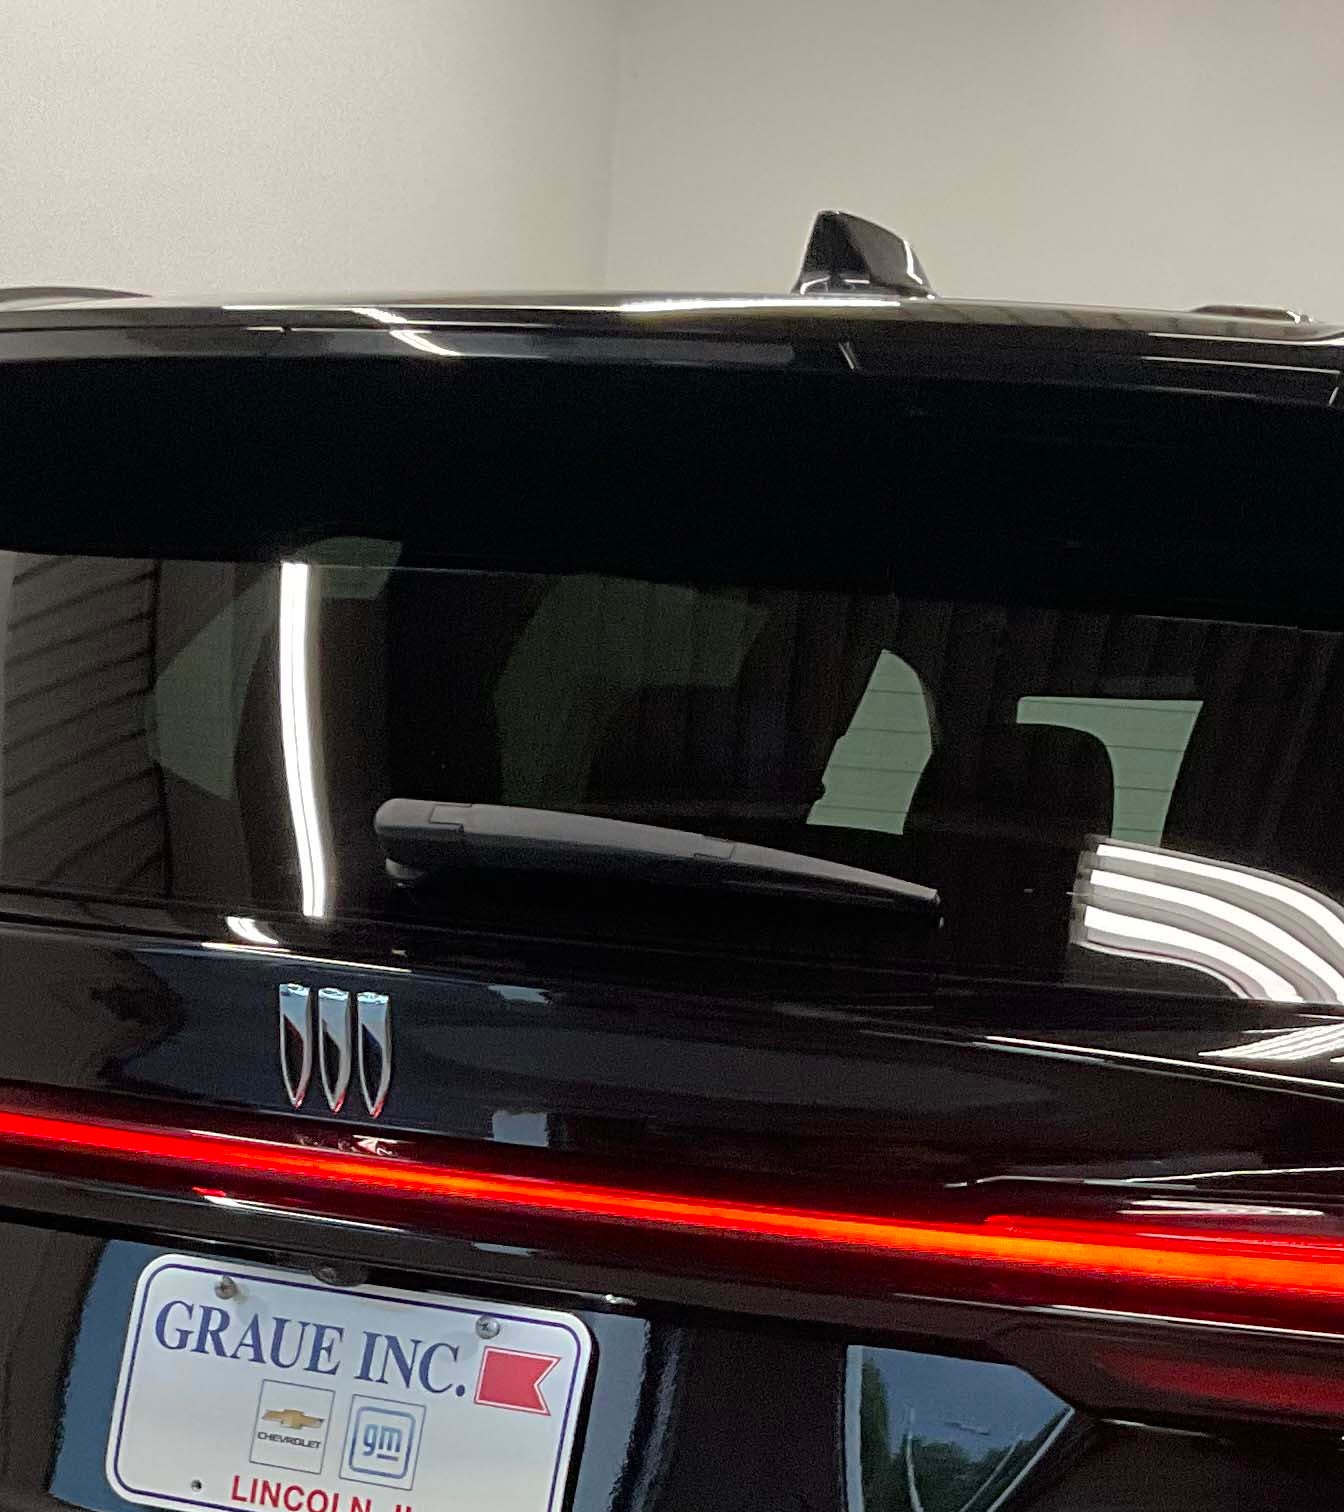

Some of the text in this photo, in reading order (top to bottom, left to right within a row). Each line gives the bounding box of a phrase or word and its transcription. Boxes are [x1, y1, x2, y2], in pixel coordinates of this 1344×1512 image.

[154, 1300, 466, 1398] GRAUE INC.
[257, 1431, 322, 1450] CHEVROLET
[361, 1424, 402, 1460] gm
